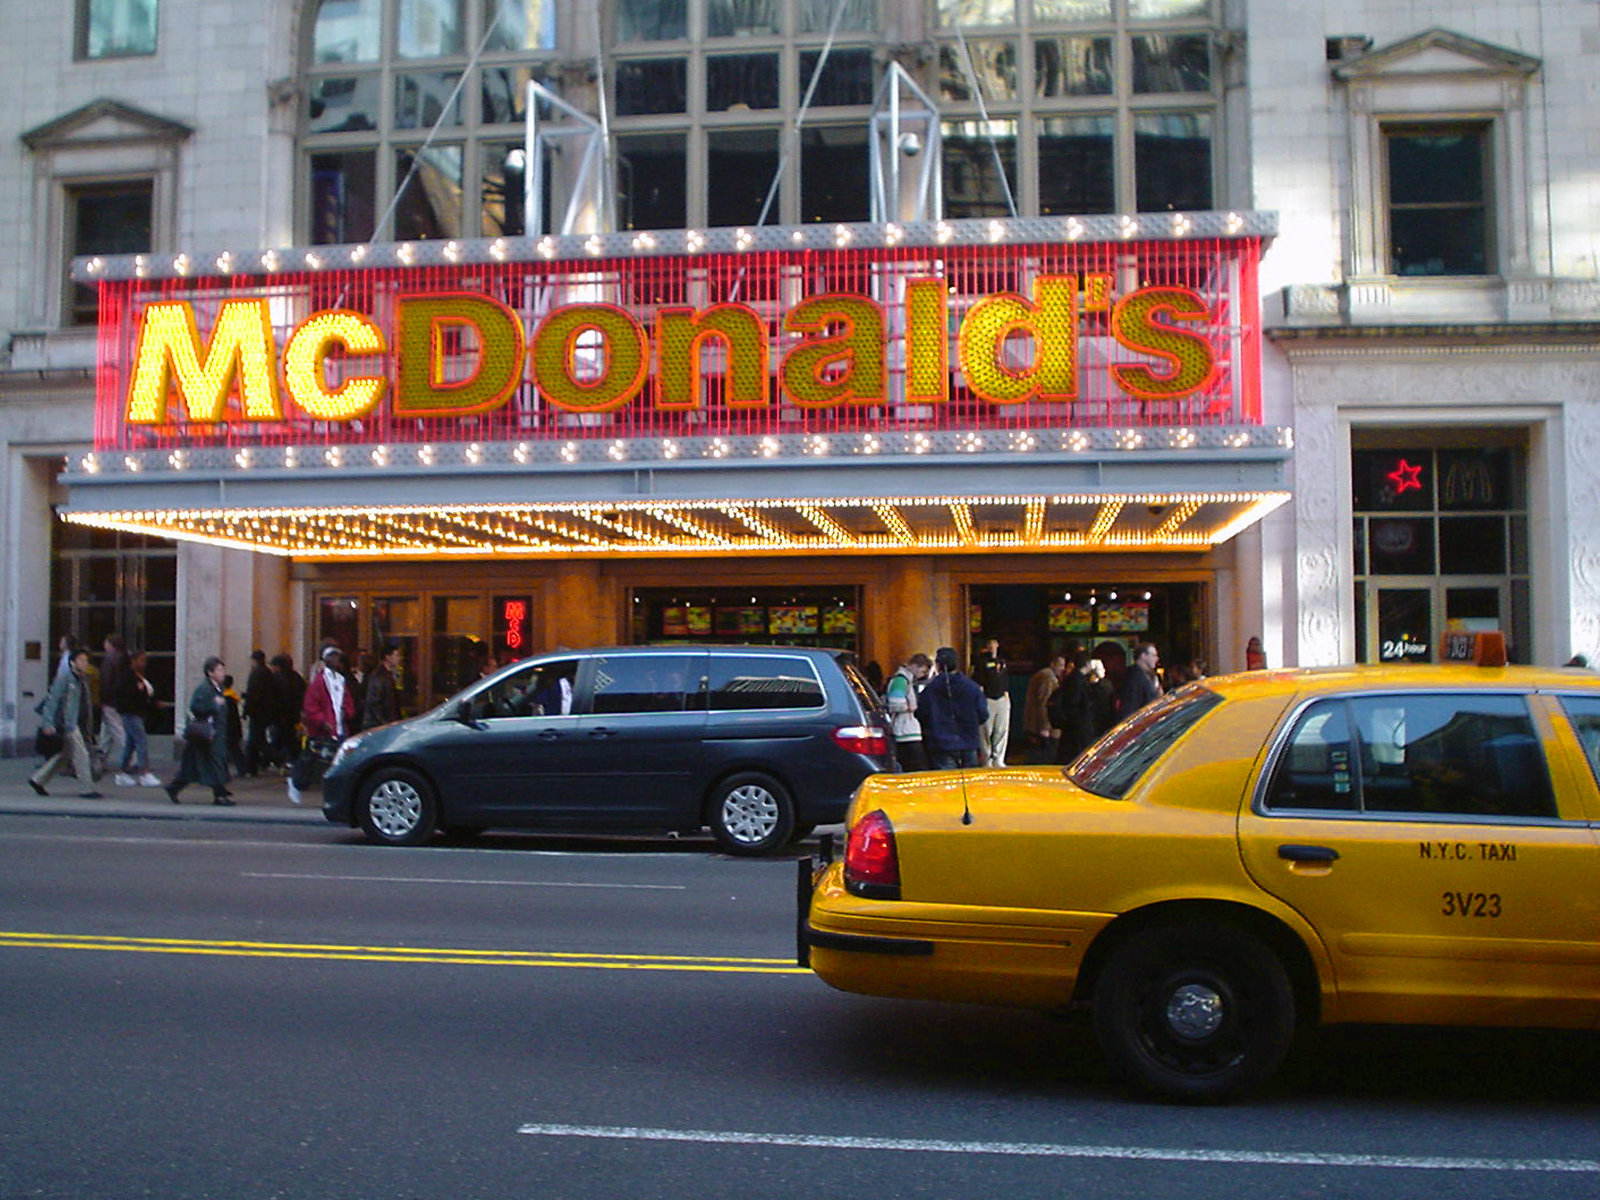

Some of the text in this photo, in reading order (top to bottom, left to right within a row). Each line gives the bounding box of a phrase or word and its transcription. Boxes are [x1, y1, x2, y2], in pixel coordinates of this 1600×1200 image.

[124, 272, 1216, 422] McDonald's
[1419, 842, 1517, 861] N.Y.C. TAXI
[1441, 891, 1502, 918] 3V23
